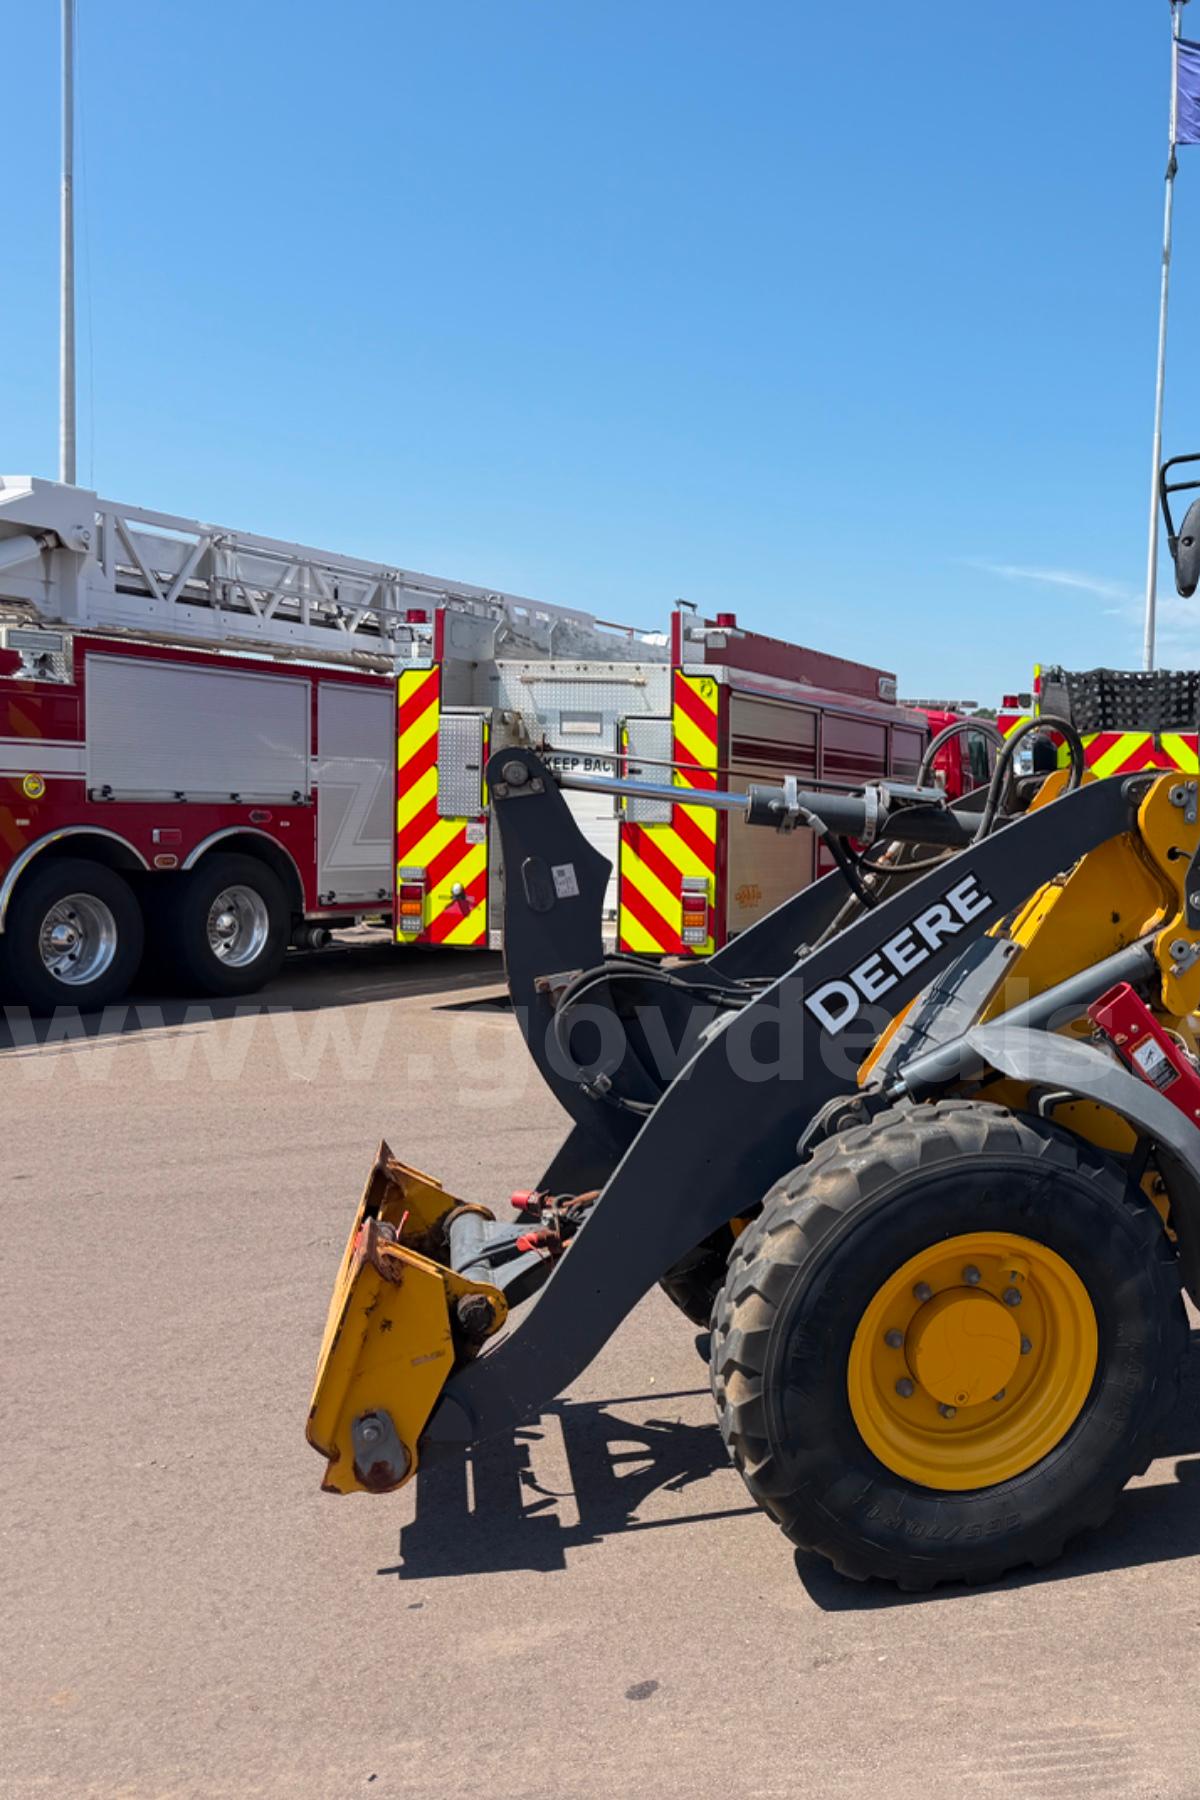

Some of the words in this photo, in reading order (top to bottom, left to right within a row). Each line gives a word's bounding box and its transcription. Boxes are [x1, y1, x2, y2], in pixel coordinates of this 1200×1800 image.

[544, 757, 579, 771] KEEP
[584, 757, 615, 772] BAC
[804, 875, 993, 1036] DEERE
